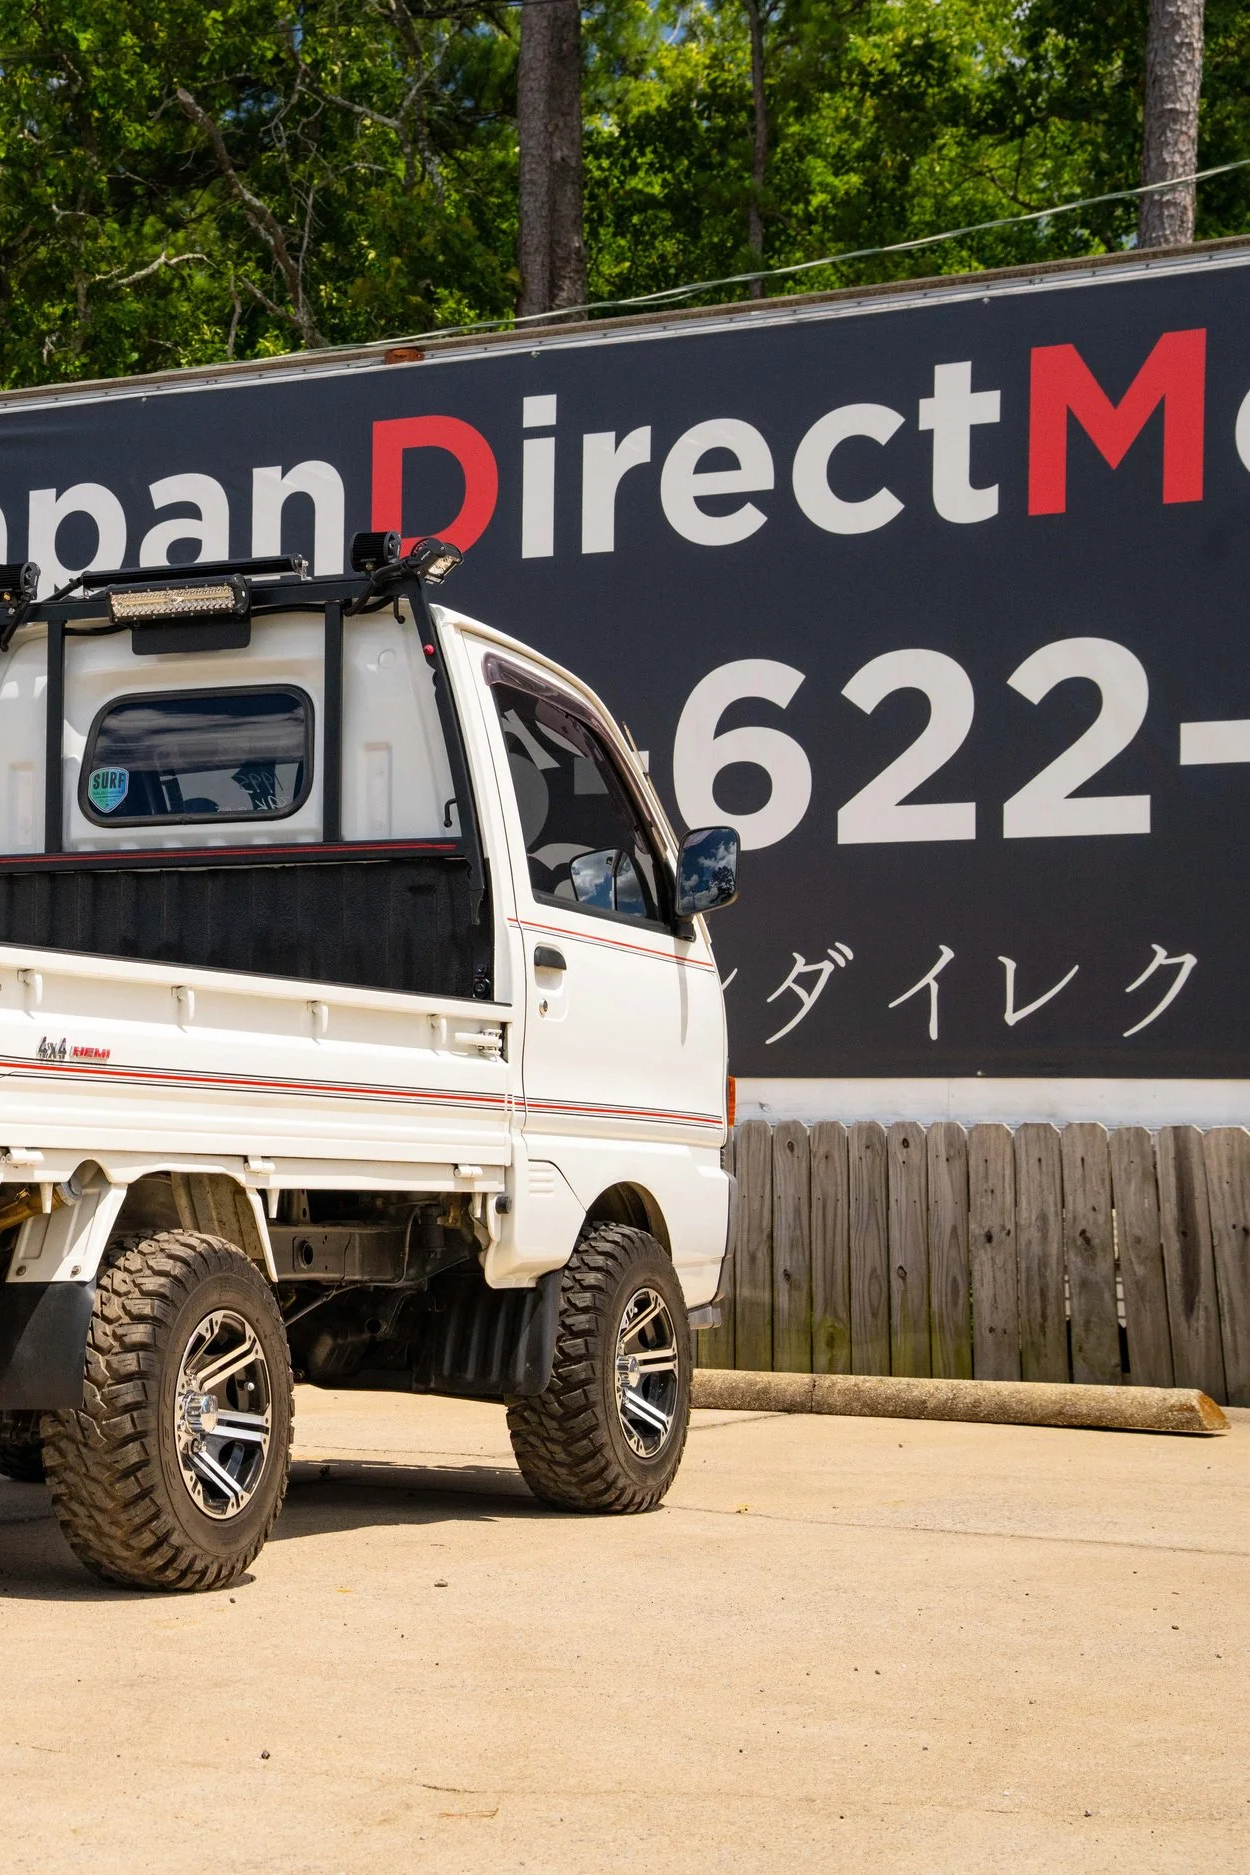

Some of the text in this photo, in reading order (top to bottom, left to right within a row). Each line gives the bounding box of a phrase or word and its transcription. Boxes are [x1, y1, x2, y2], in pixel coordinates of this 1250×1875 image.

[93, 771, 125, 789] SURF
[720, 940, 1198, 1046] ダイレク
[72, 1046, 111, 1059] HEMI
